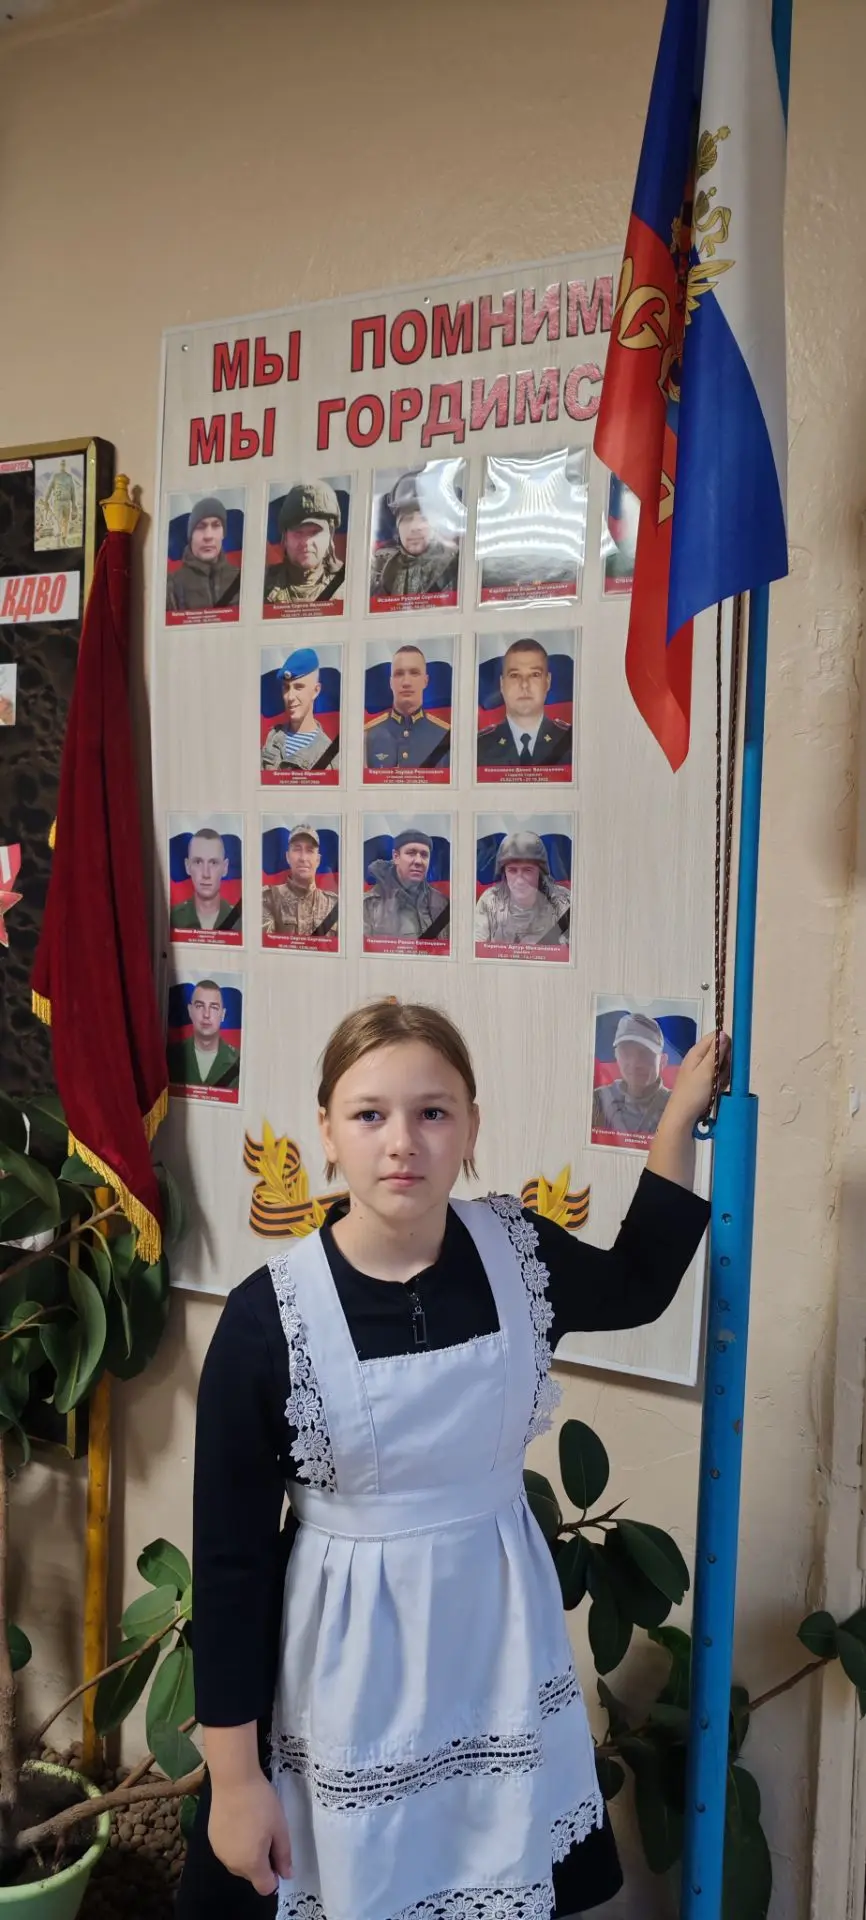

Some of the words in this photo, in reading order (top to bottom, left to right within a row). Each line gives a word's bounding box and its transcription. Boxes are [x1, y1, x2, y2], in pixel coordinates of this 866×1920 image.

[213, 330, 301, 392] МЫ
[351, 274, 613, 372] ПОМНИМ
[188, 407, 276, 466] МЫ
[1, 574, 67, 622] КДВО
